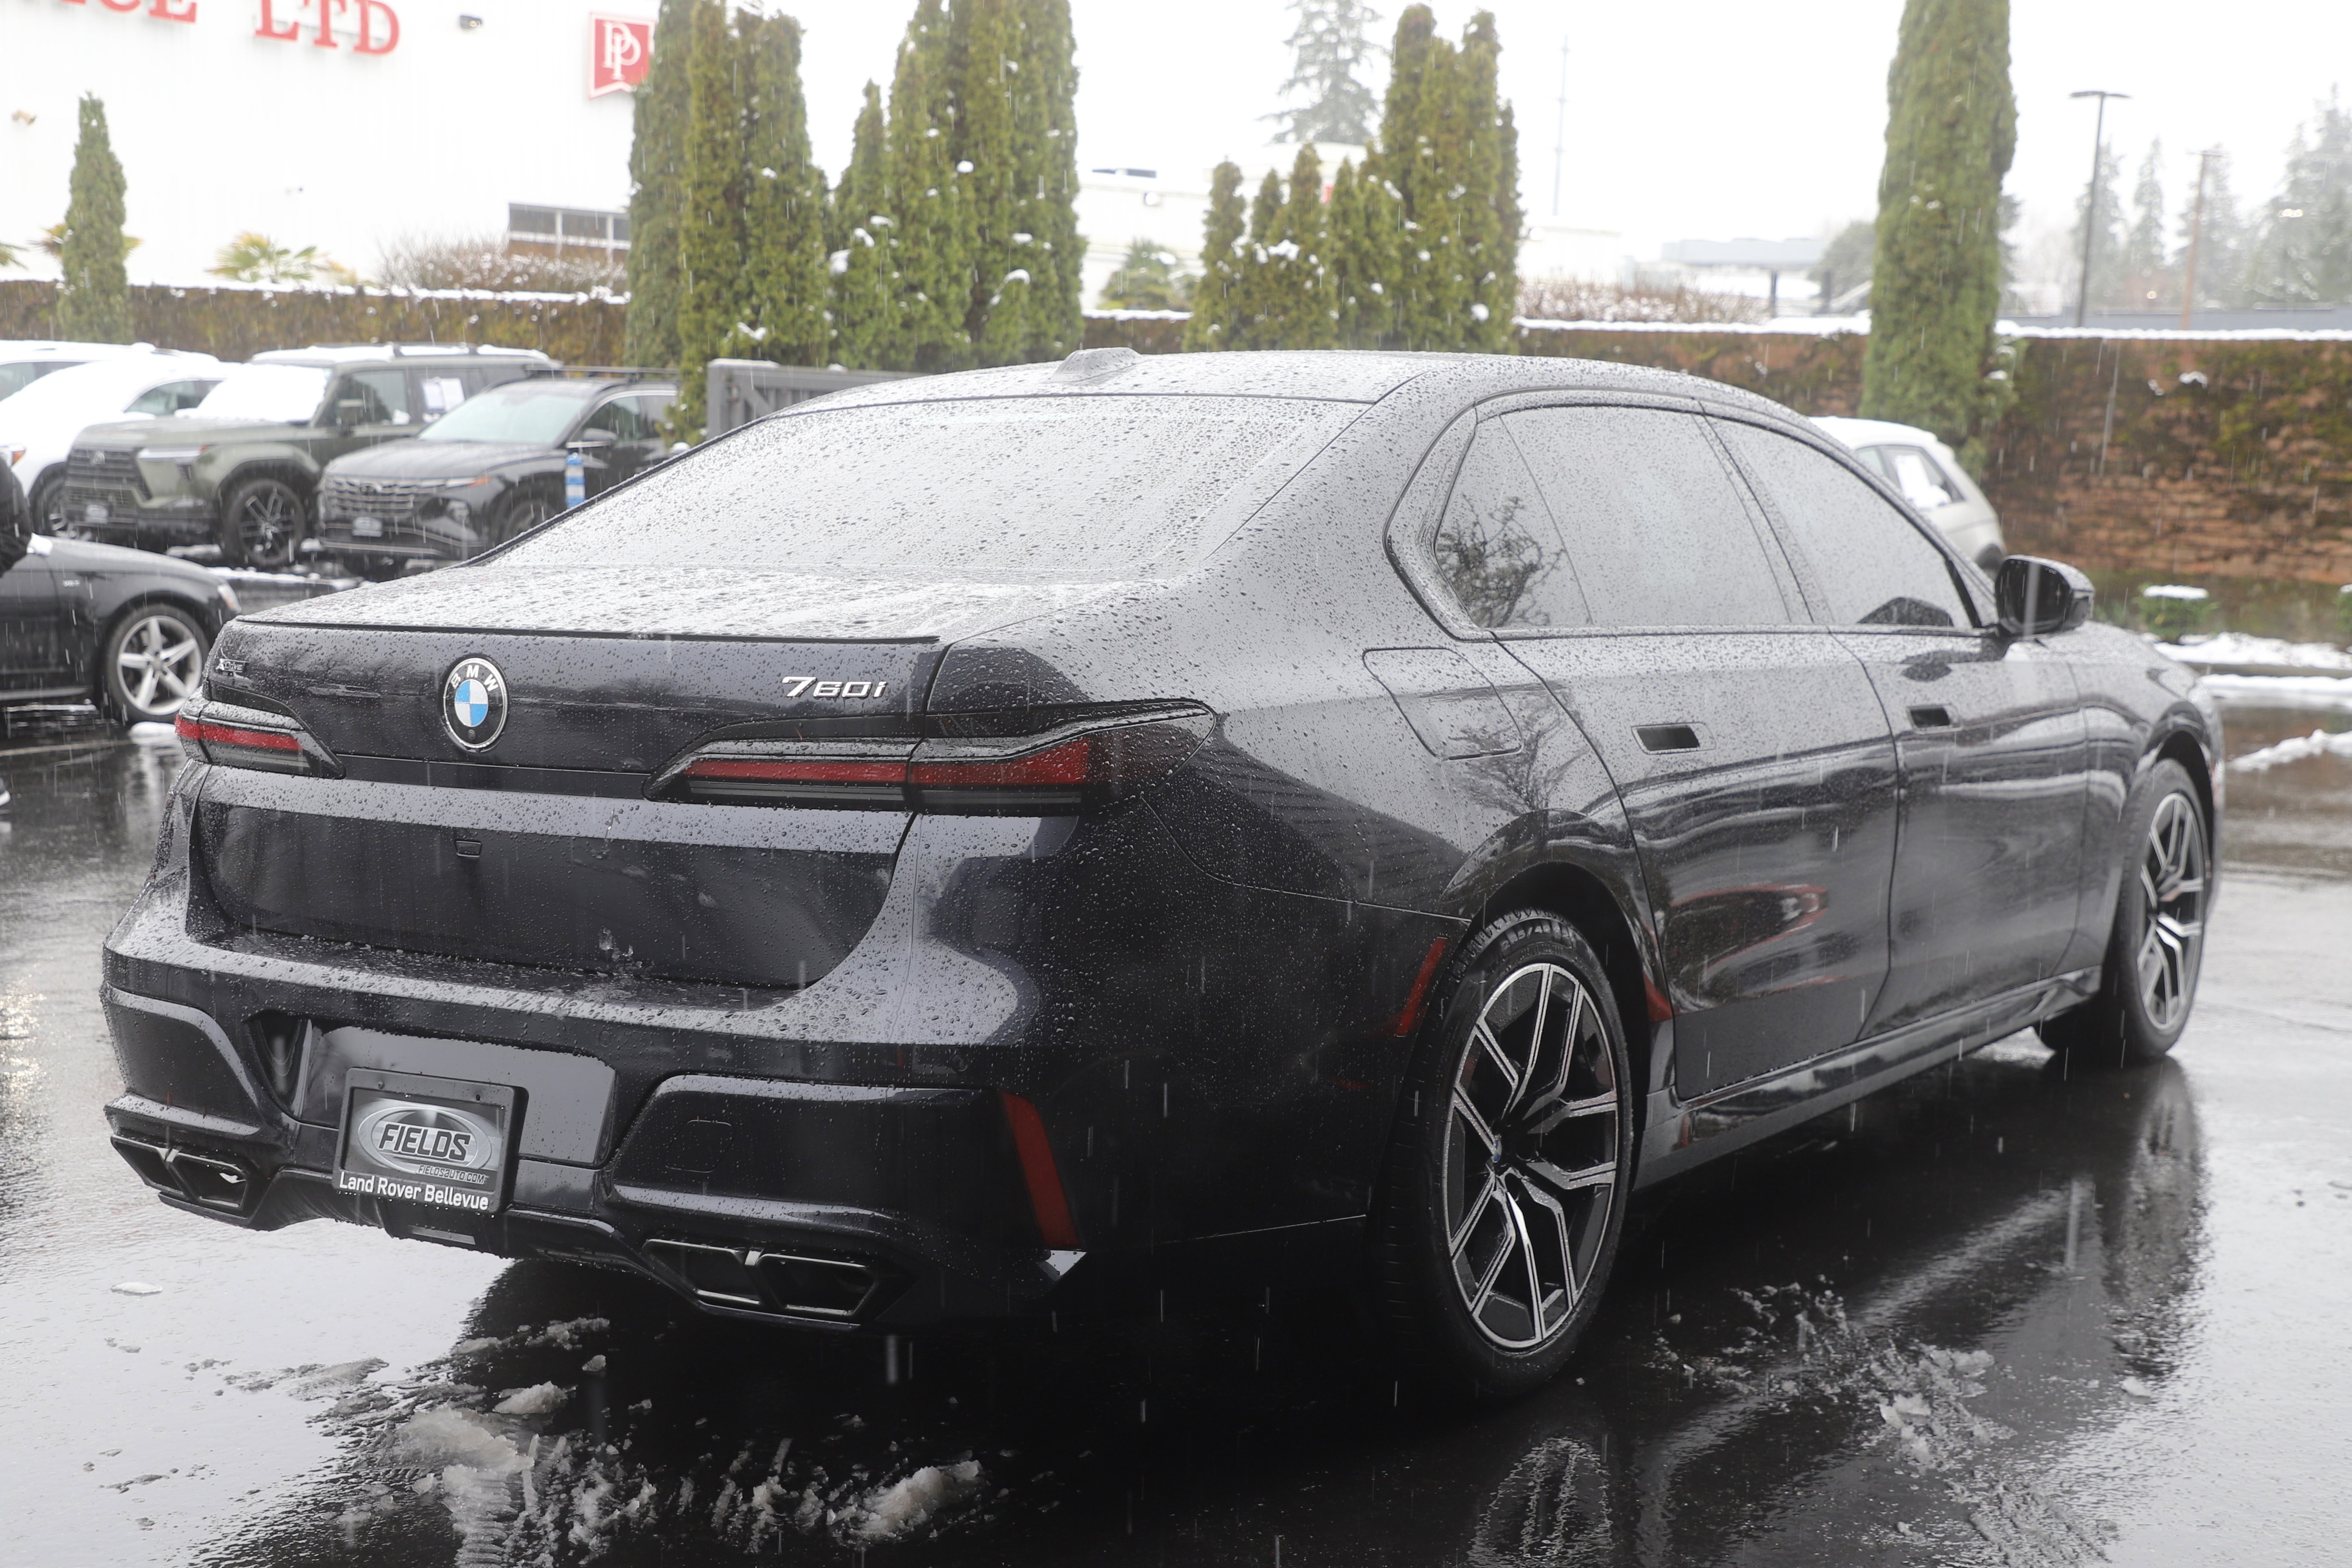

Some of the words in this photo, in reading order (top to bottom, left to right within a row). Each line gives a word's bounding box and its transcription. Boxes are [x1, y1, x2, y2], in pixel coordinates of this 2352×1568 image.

[256, 0, 399, 55] LTD
[451, 665, 498, 692] BMW
[782, 676, 888, 698] 760i
[379, 1124, 471, 1161] FIELDS
[339, 1171, 375, 1193] Land
[377, 1177, 422, 1200] Rover
[424, 1184, 489, 1211] Bellevue
